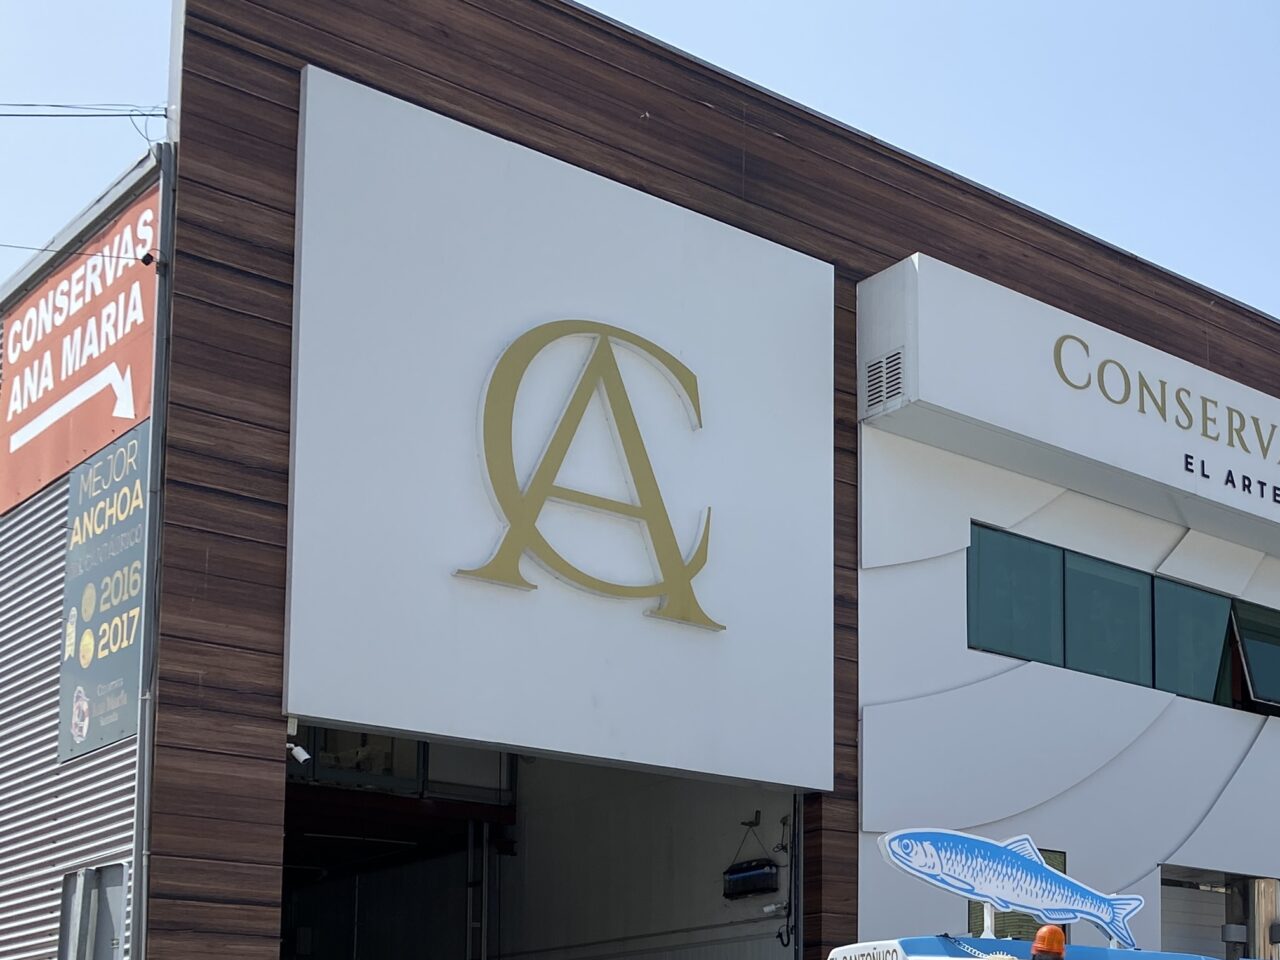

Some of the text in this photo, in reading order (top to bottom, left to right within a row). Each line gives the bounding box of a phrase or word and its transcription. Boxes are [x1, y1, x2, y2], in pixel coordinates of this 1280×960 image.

[7, 208, 154, 365] CONSERVAS
[7, 280, 145, 422] ANA MARIA
[79, 439, 138, 505] MEJOR
[1184, 454, 1210, 479] EL
[69, 479, 144, 551] ANCHOA
[100, 560, 142, 613] 2016
[97, 606, 141, 659] 2017
